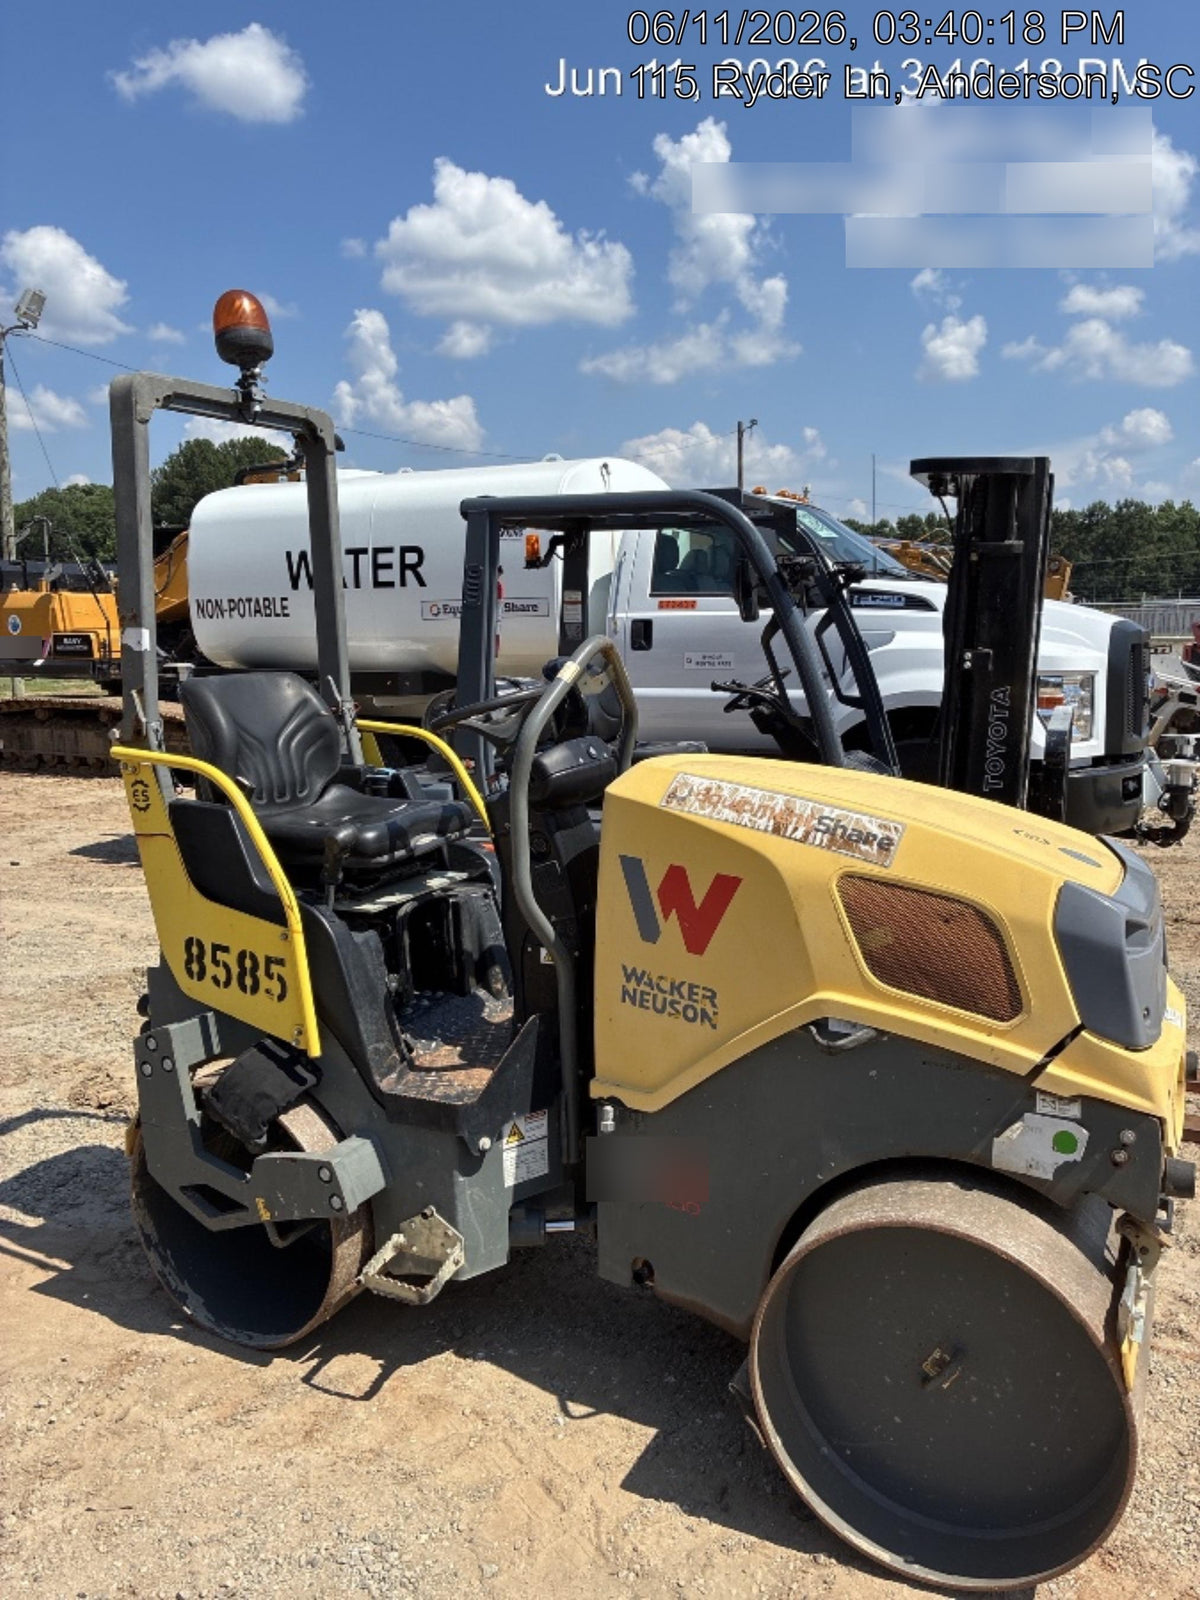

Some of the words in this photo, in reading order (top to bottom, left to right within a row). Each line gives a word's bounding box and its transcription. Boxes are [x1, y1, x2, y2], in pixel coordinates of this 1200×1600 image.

[286, 546, 427, 591] WTER
[196, 597, 291, 620] NON-POTABLE
[504, 601, 539, 613] Share
[983, 686, 1012, 791] TOYOTA
[814, 815, 896, 852] Share
[184, 936, 288, 1003] 8585
[621, 963, 720, 1009] WACKER
[620, 984, 719, 1030] NEUSON
